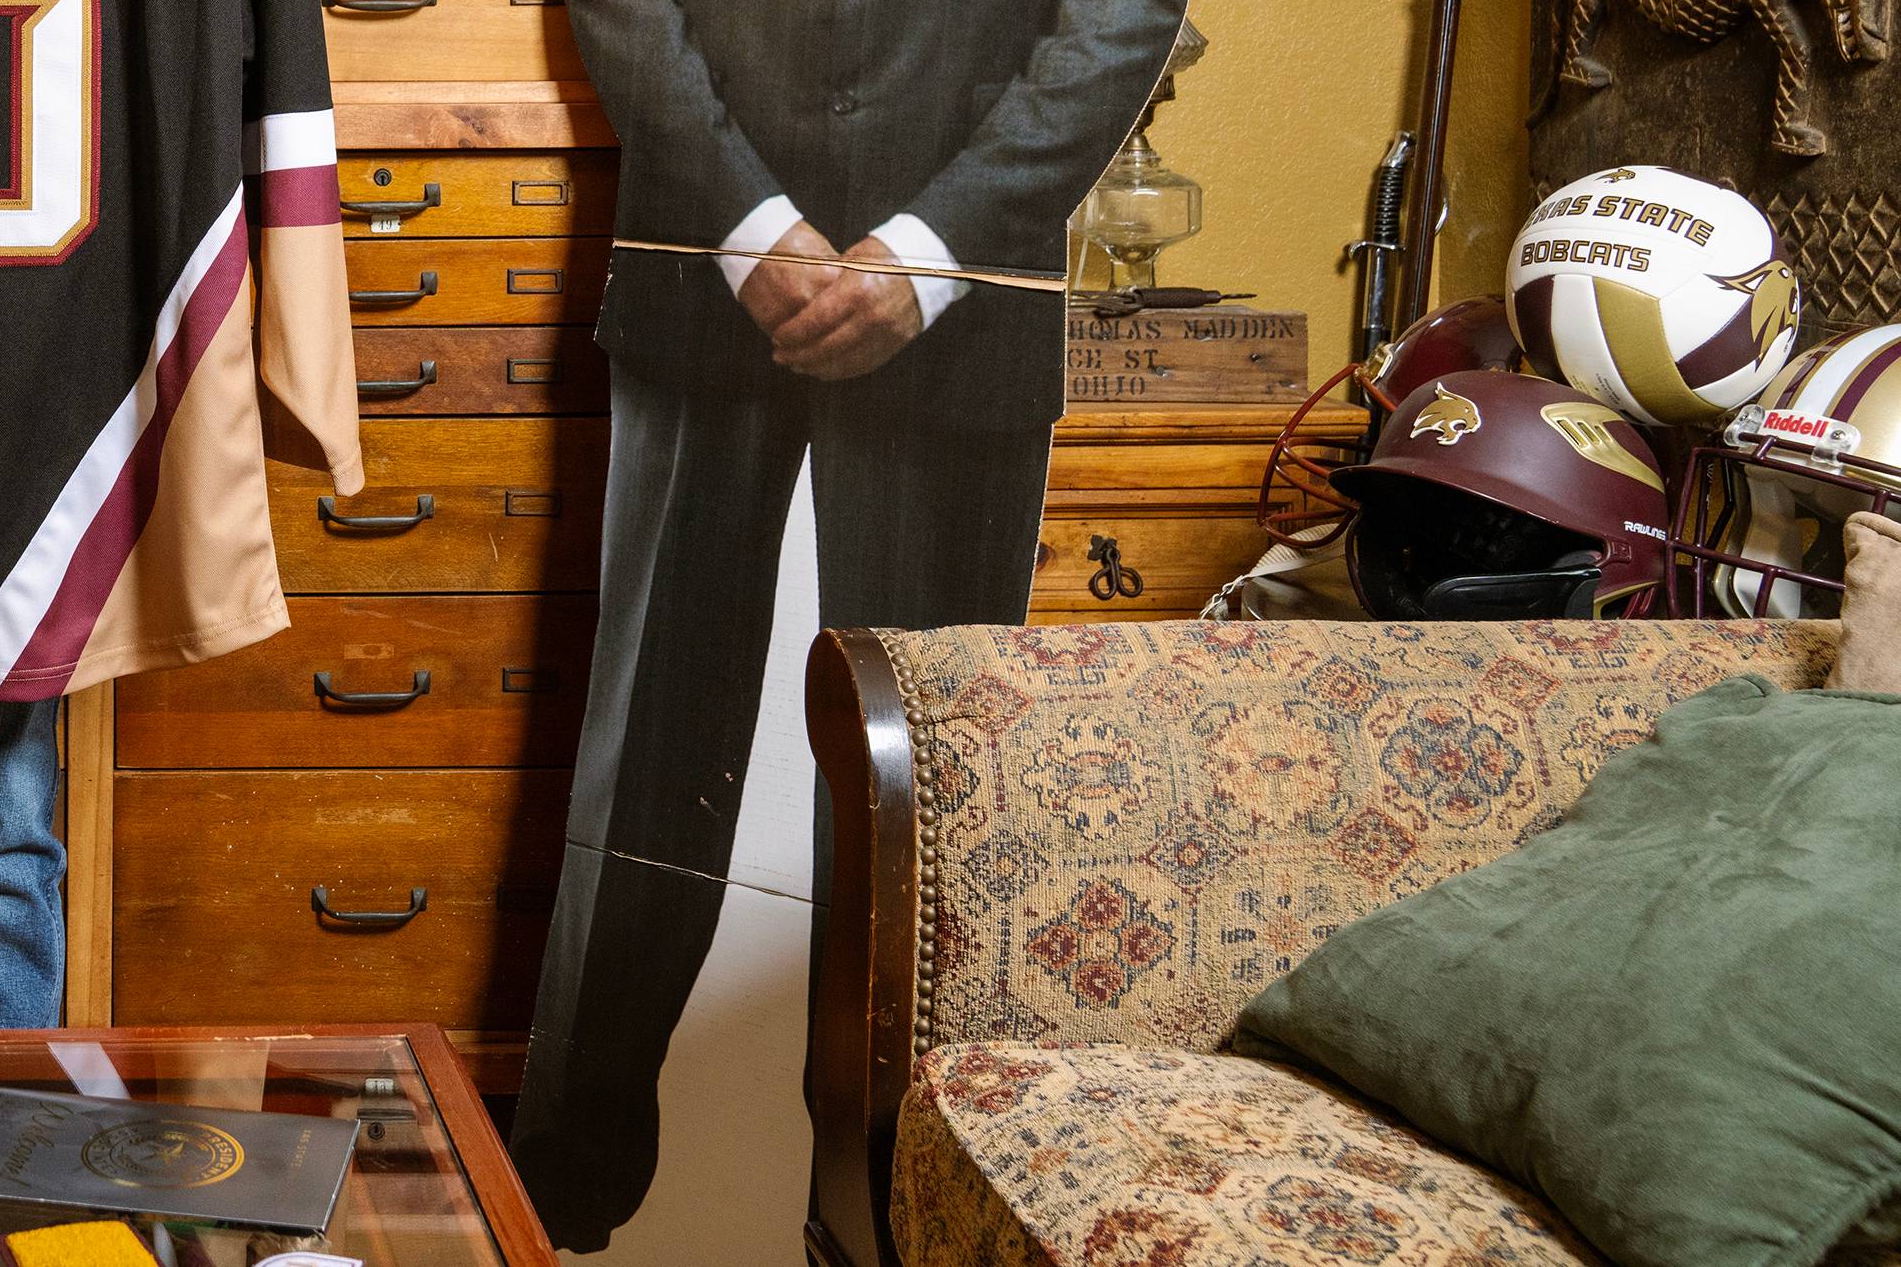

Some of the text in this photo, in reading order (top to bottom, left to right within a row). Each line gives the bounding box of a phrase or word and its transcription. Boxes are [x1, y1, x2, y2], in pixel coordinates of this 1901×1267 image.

[1593, 194, 1715, 248] STATE
[1520, 239, 1651, 273] BOBCATS
[1068, 317, 1296, 341] HOMAS MADDEN
[1124, 347, 1159, 371] ST
[1072, 375, 1146, 396] OHIO
[1763, 411, 1829, 439] Riddell
